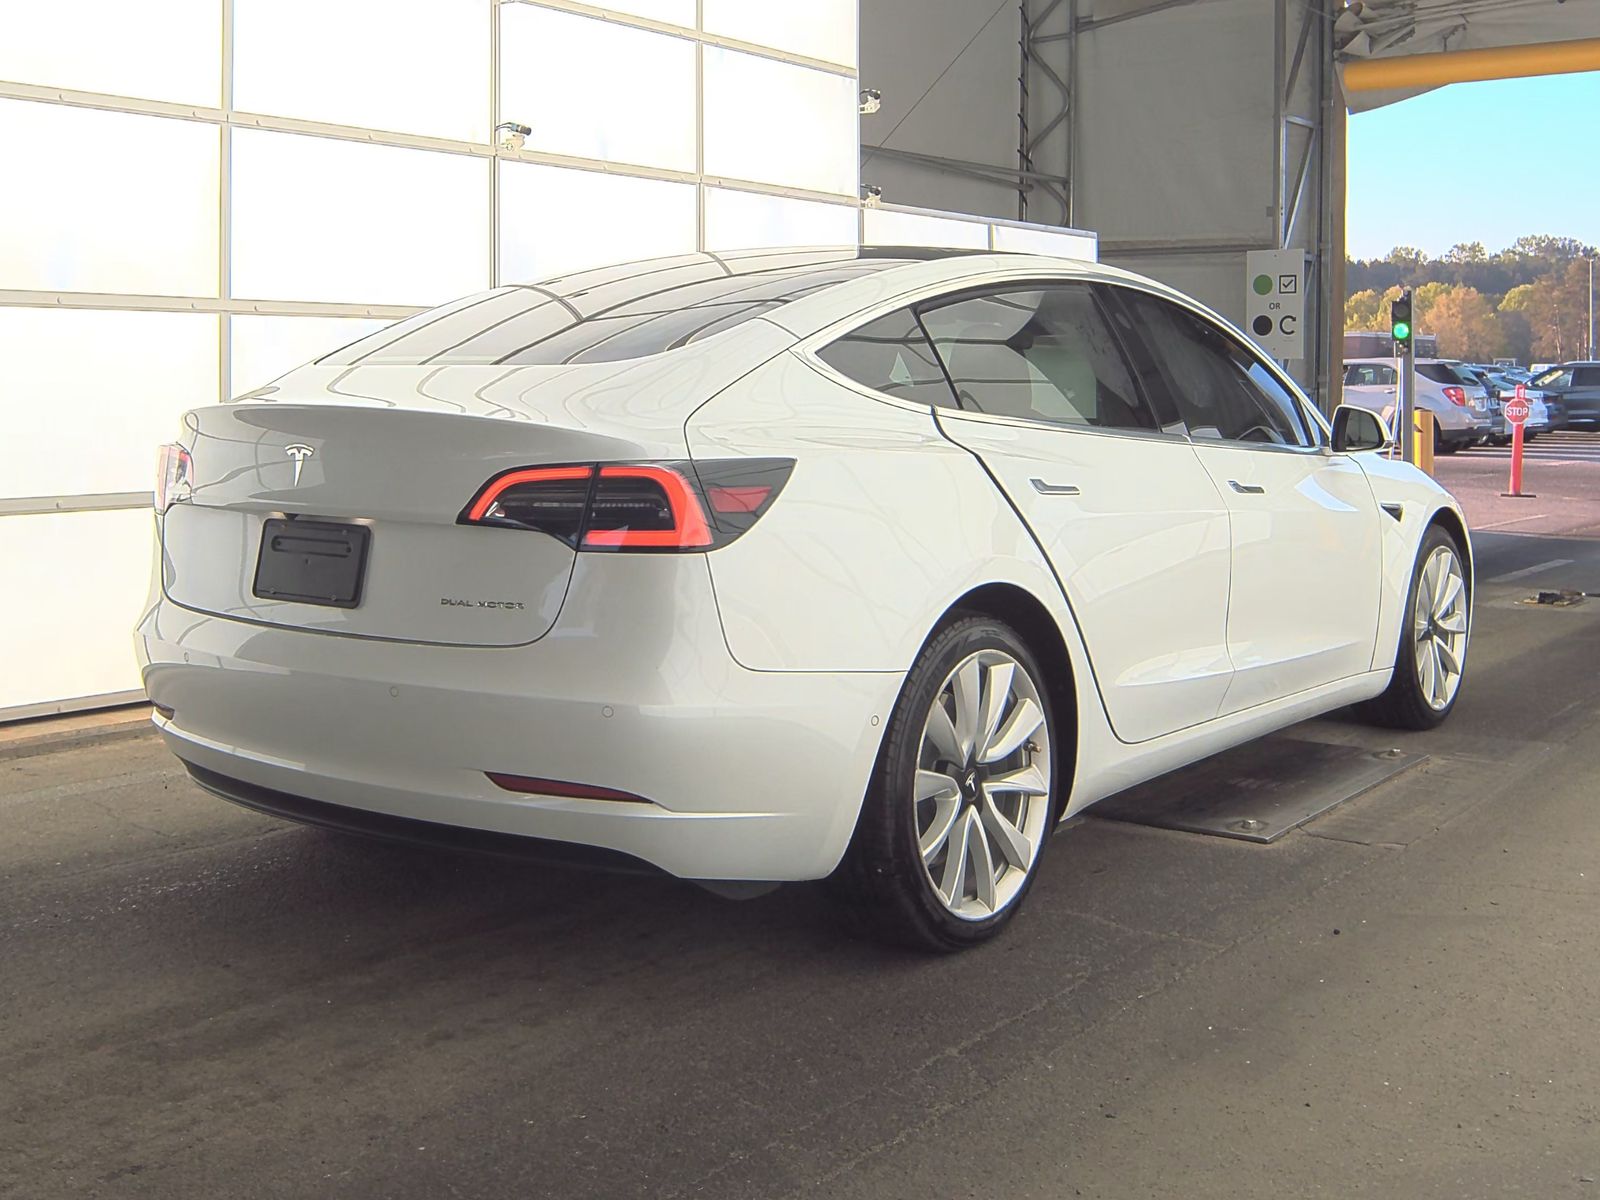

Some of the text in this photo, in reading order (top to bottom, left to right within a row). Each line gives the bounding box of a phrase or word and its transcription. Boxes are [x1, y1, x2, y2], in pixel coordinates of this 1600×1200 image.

[1268, 302, 1281, 310] OR
[1506, 407, 1528, 416] STOP
[440, 598, 525, 610] DUAL MOTOR
